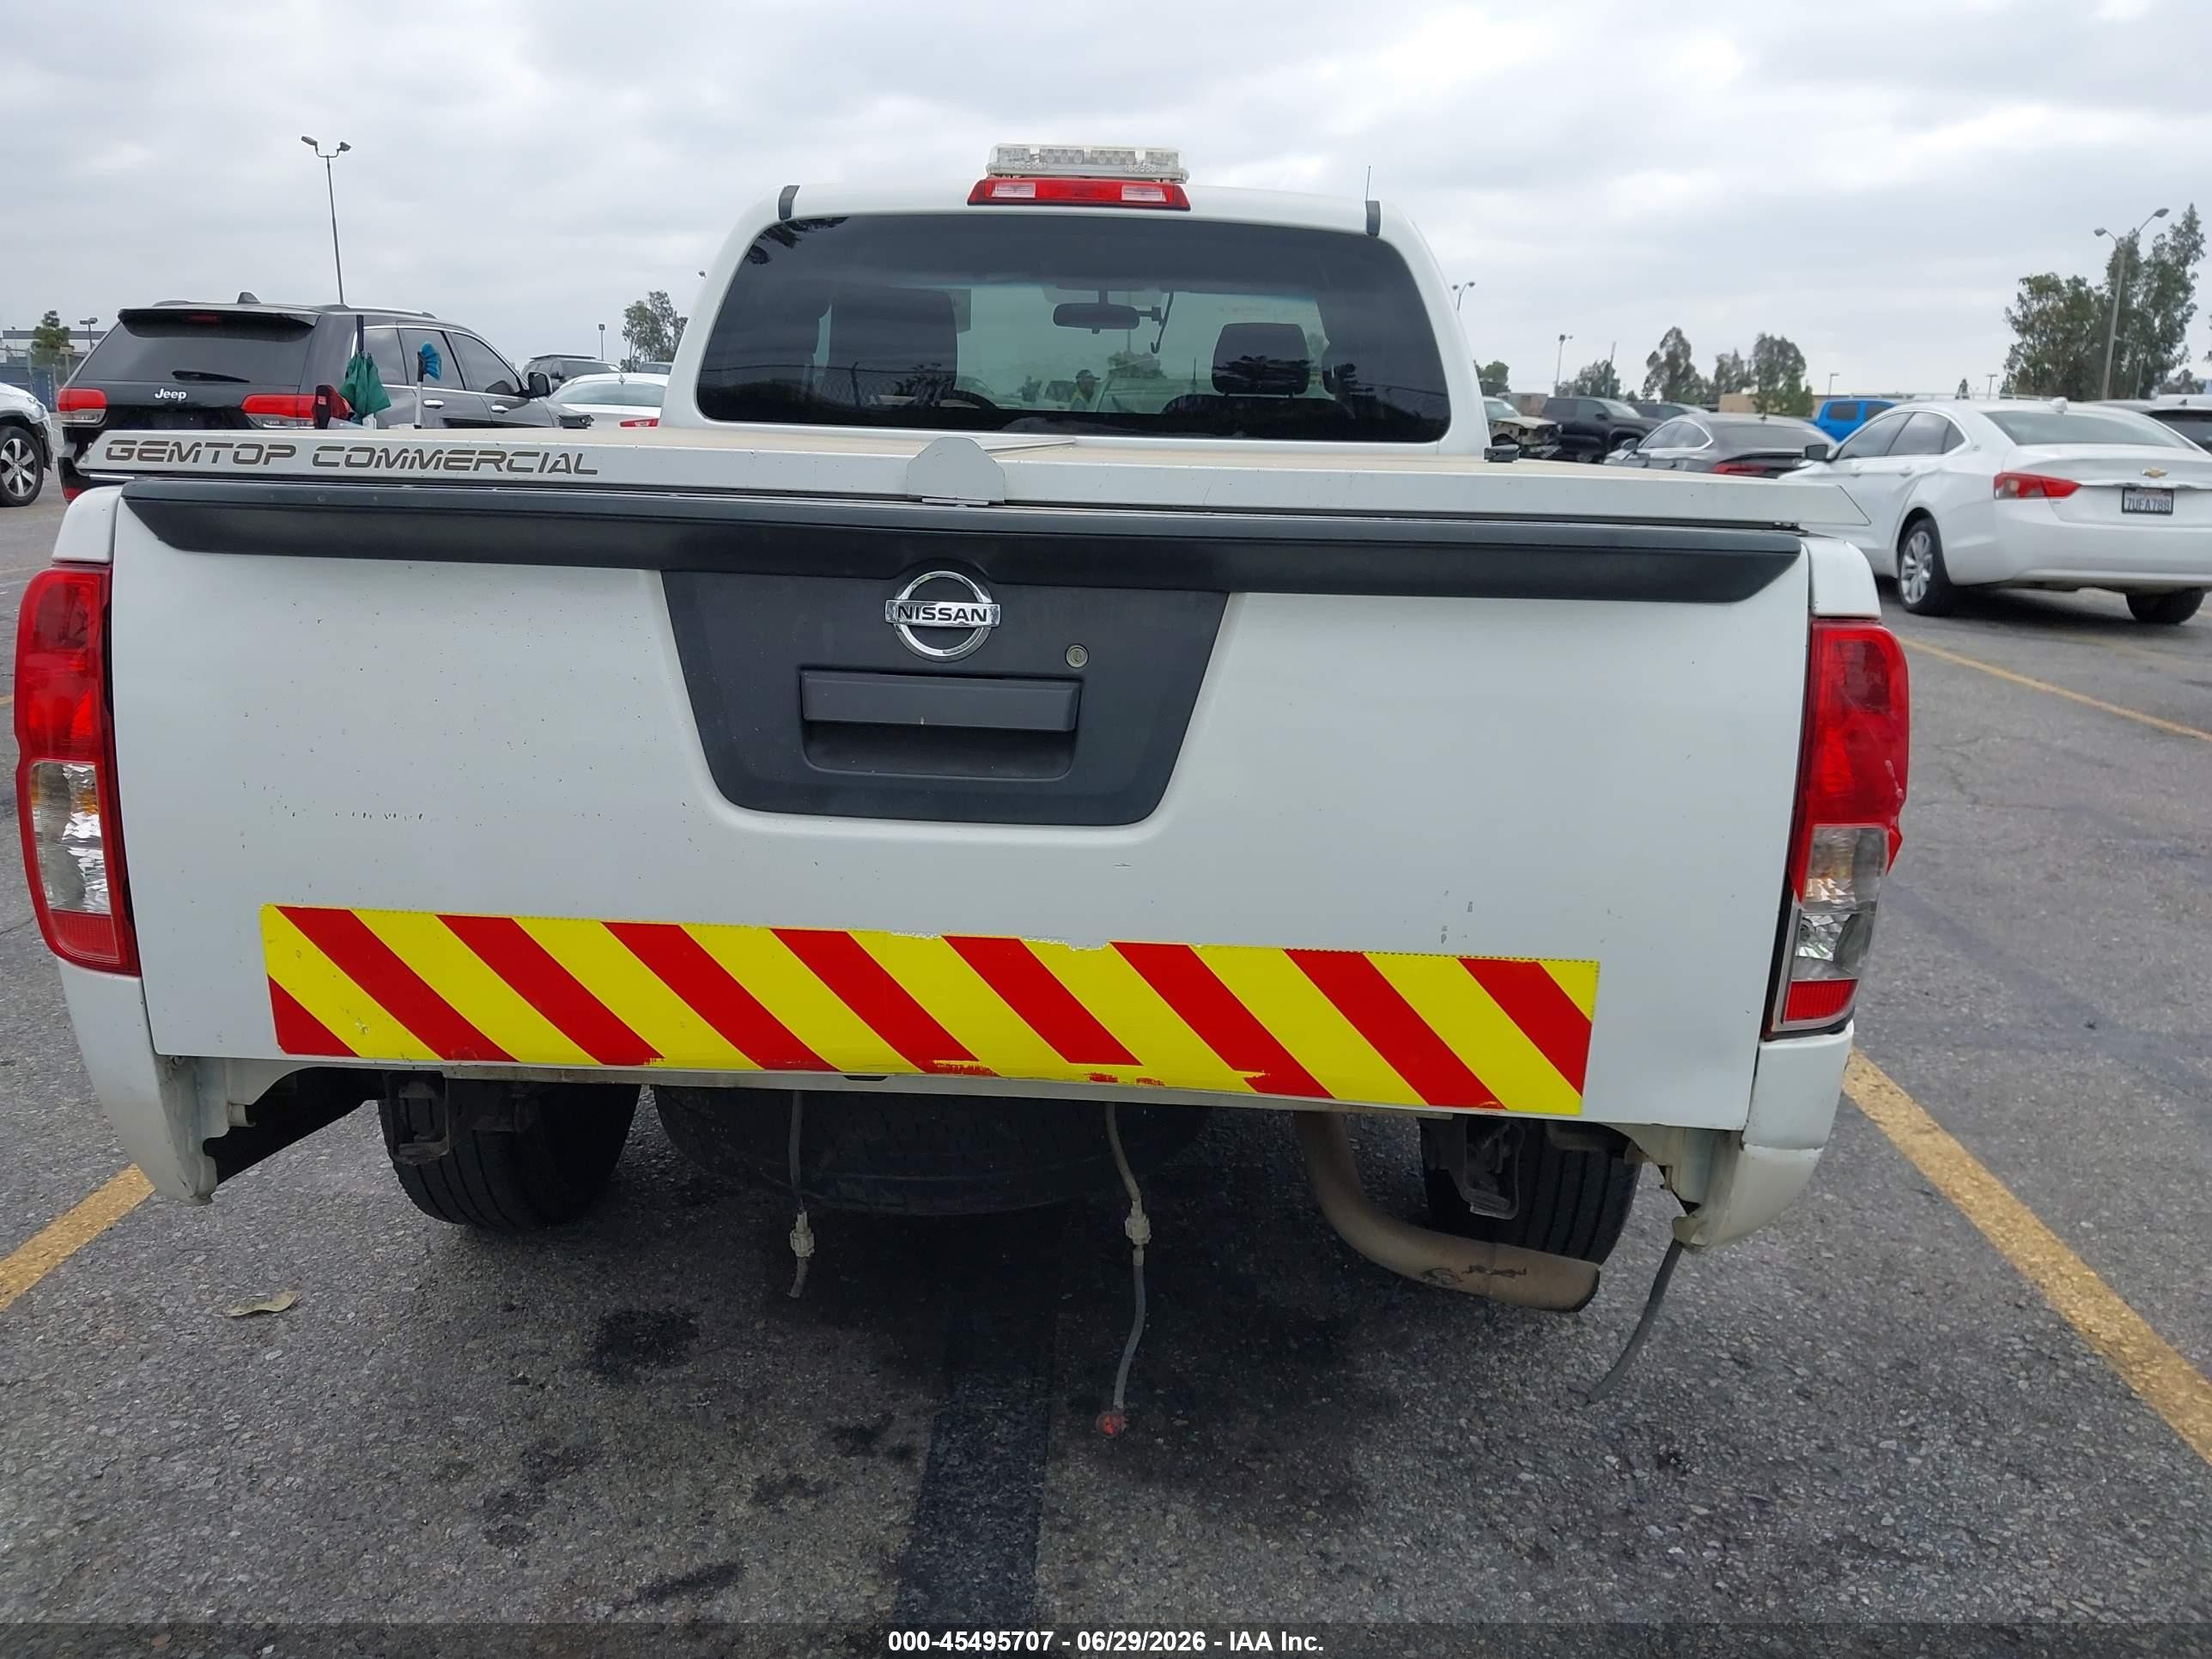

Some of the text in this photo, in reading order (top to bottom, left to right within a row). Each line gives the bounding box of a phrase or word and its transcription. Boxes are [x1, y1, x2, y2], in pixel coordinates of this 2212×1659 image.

[155, 387, 187, 402] Jeep
[105, 439, 599, 476] GEMTOP COMMERCIAL
[896, 605, 988, 623] NISSAN
